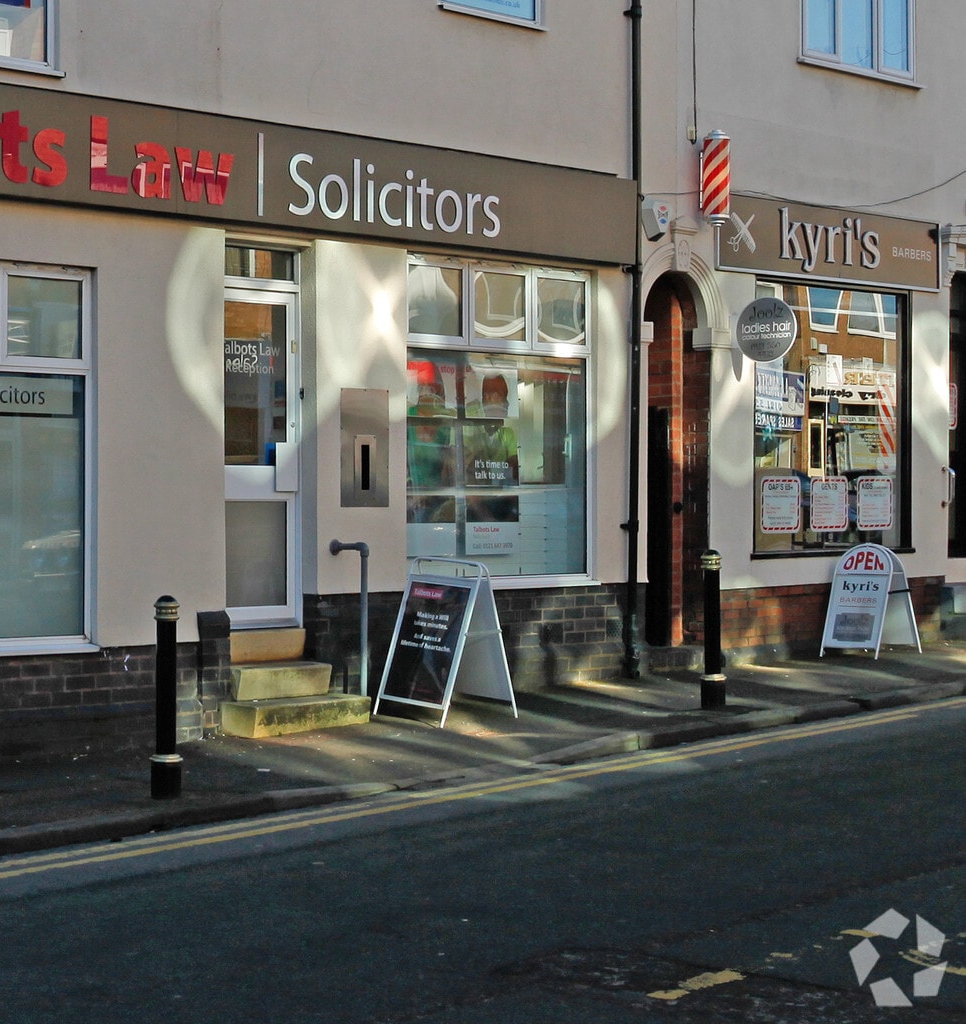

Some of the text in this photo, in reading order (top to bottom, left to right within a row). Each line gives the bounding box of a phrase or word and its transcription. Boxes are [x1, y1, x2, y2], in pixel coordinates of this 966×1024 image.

[89, 116, 235, 206] Law
[288, 153, 500, 239] Solicitors
[778, 207, 932, 272] kyri's BARBERS
[741, 320, 792, 334] ladies hair
[224, 340, 280, 357] albots Law
[226, 361, 274, 377] Reception
[474, 460, 485, 468] It's
[486, 460, 500, 469] time
[475, 472, 487, 480] talk
[843, 551, 885, 571] OPEN
[842, 581, 879, 593] kyri's
